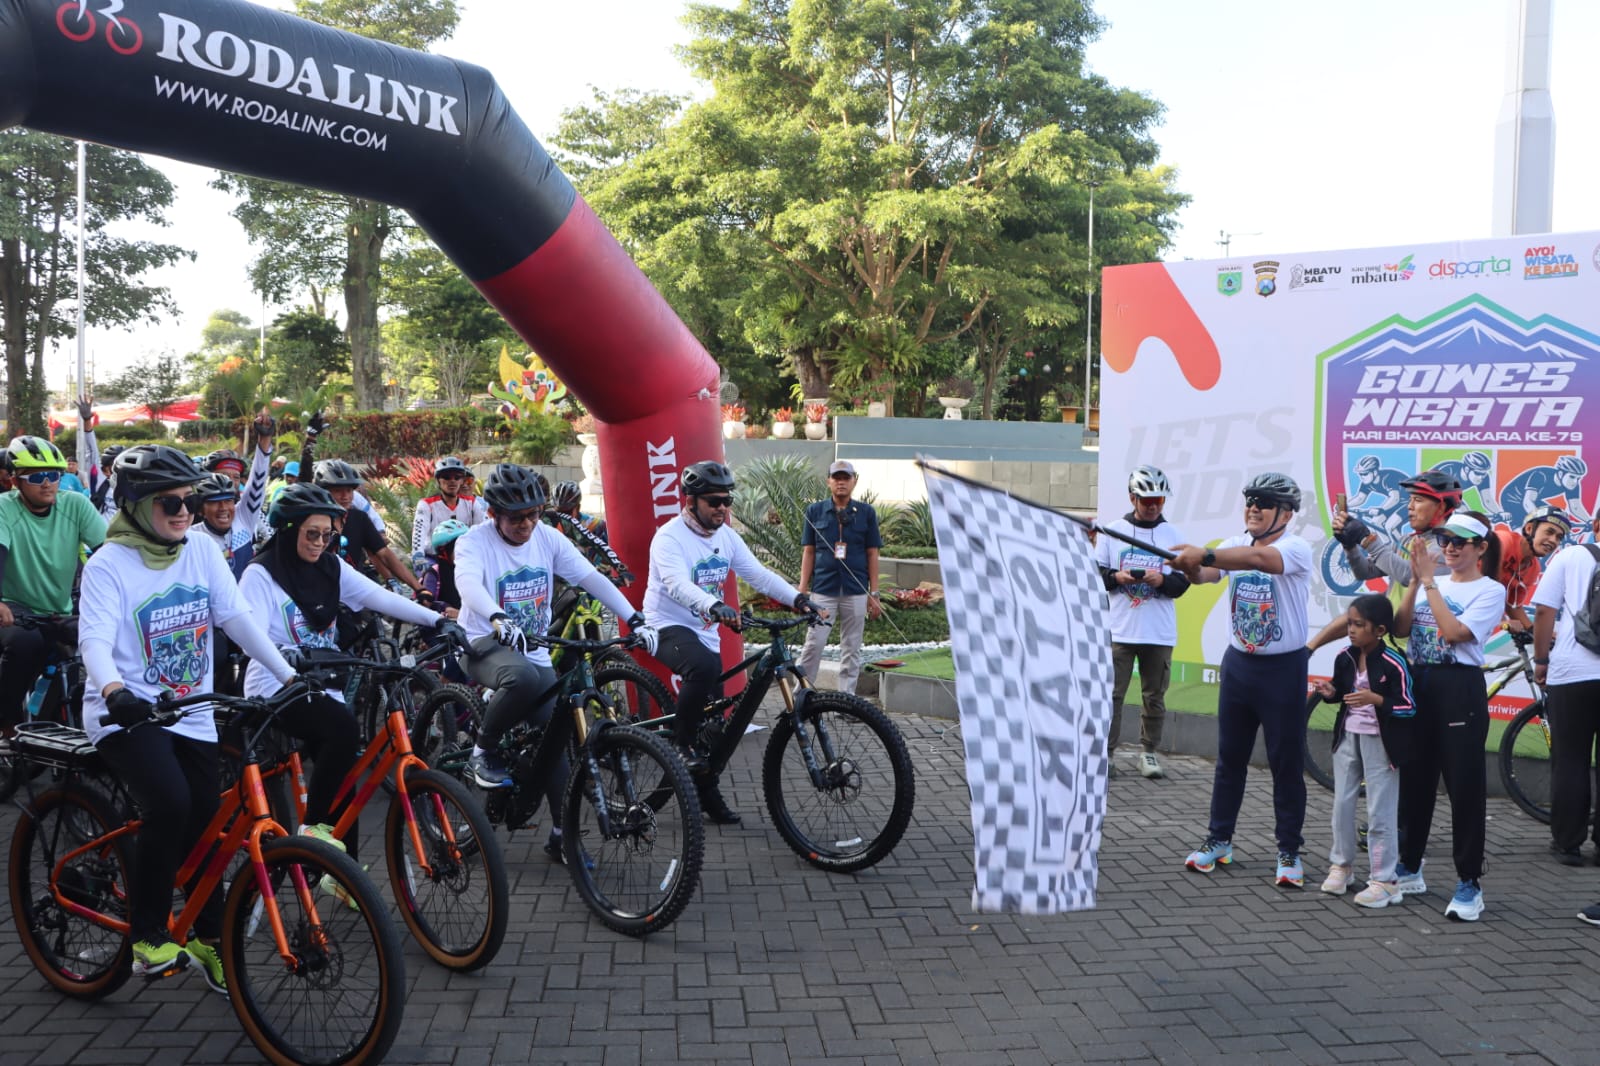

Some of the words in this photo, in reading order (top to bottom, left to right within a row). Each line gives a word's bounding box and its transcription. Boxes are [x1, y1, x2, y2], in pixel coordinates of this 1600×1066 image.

[156, 12, 461, 136] RODALINK
[154, 75, 388, 152] WWW.RODALINK.COM
[1525, 246, 1555, 257] AYO!
[1525, 255, 1575, 266] WISATA
[1304, 266, 1342, 275] MBATU
[1304, 276, 1324, 284] SAE
[1351, 271, 1398, 284] mbatu
[1356, 362, 1576, 394] GOWES
[1343, 397, 1584, 427] WISATA
[1343, 431, 1382, 440] HARI
[1385, 431, 1521, 441] BHAYANGKARA
[1525, 432, 1583, 442] KE-79
[151, 598, 208, 621] GOWES
